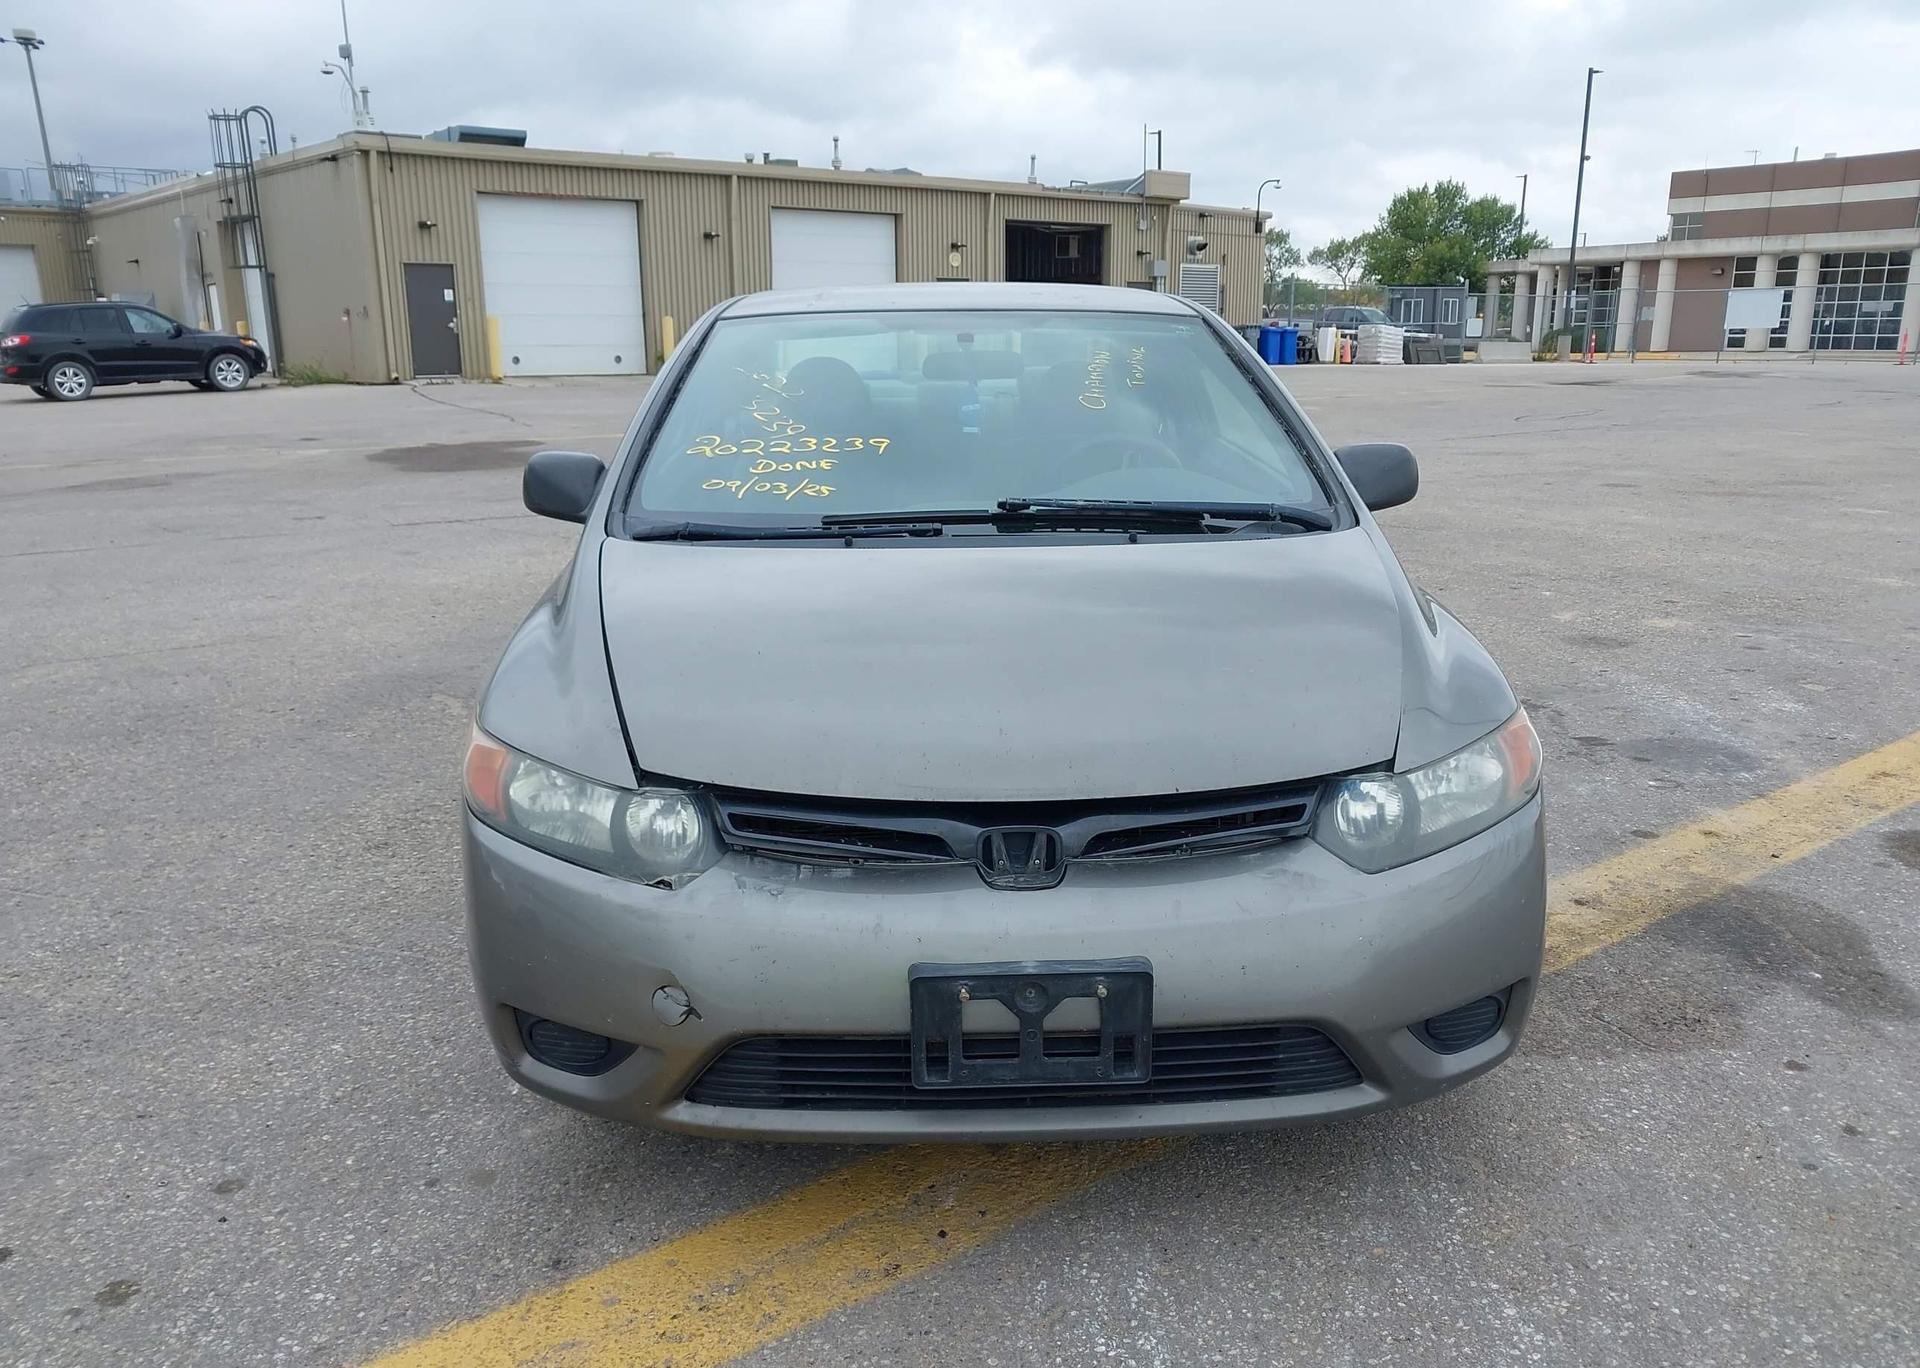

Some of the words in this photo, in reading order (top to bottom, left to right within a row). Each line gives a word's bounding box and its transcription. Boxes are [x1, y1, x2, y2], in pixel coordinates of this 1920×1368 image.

[686, 435, 891, 457] 20223239
[749, 459, 838, 473] DONE
[702, 476, 836, 500] 09/03/25
